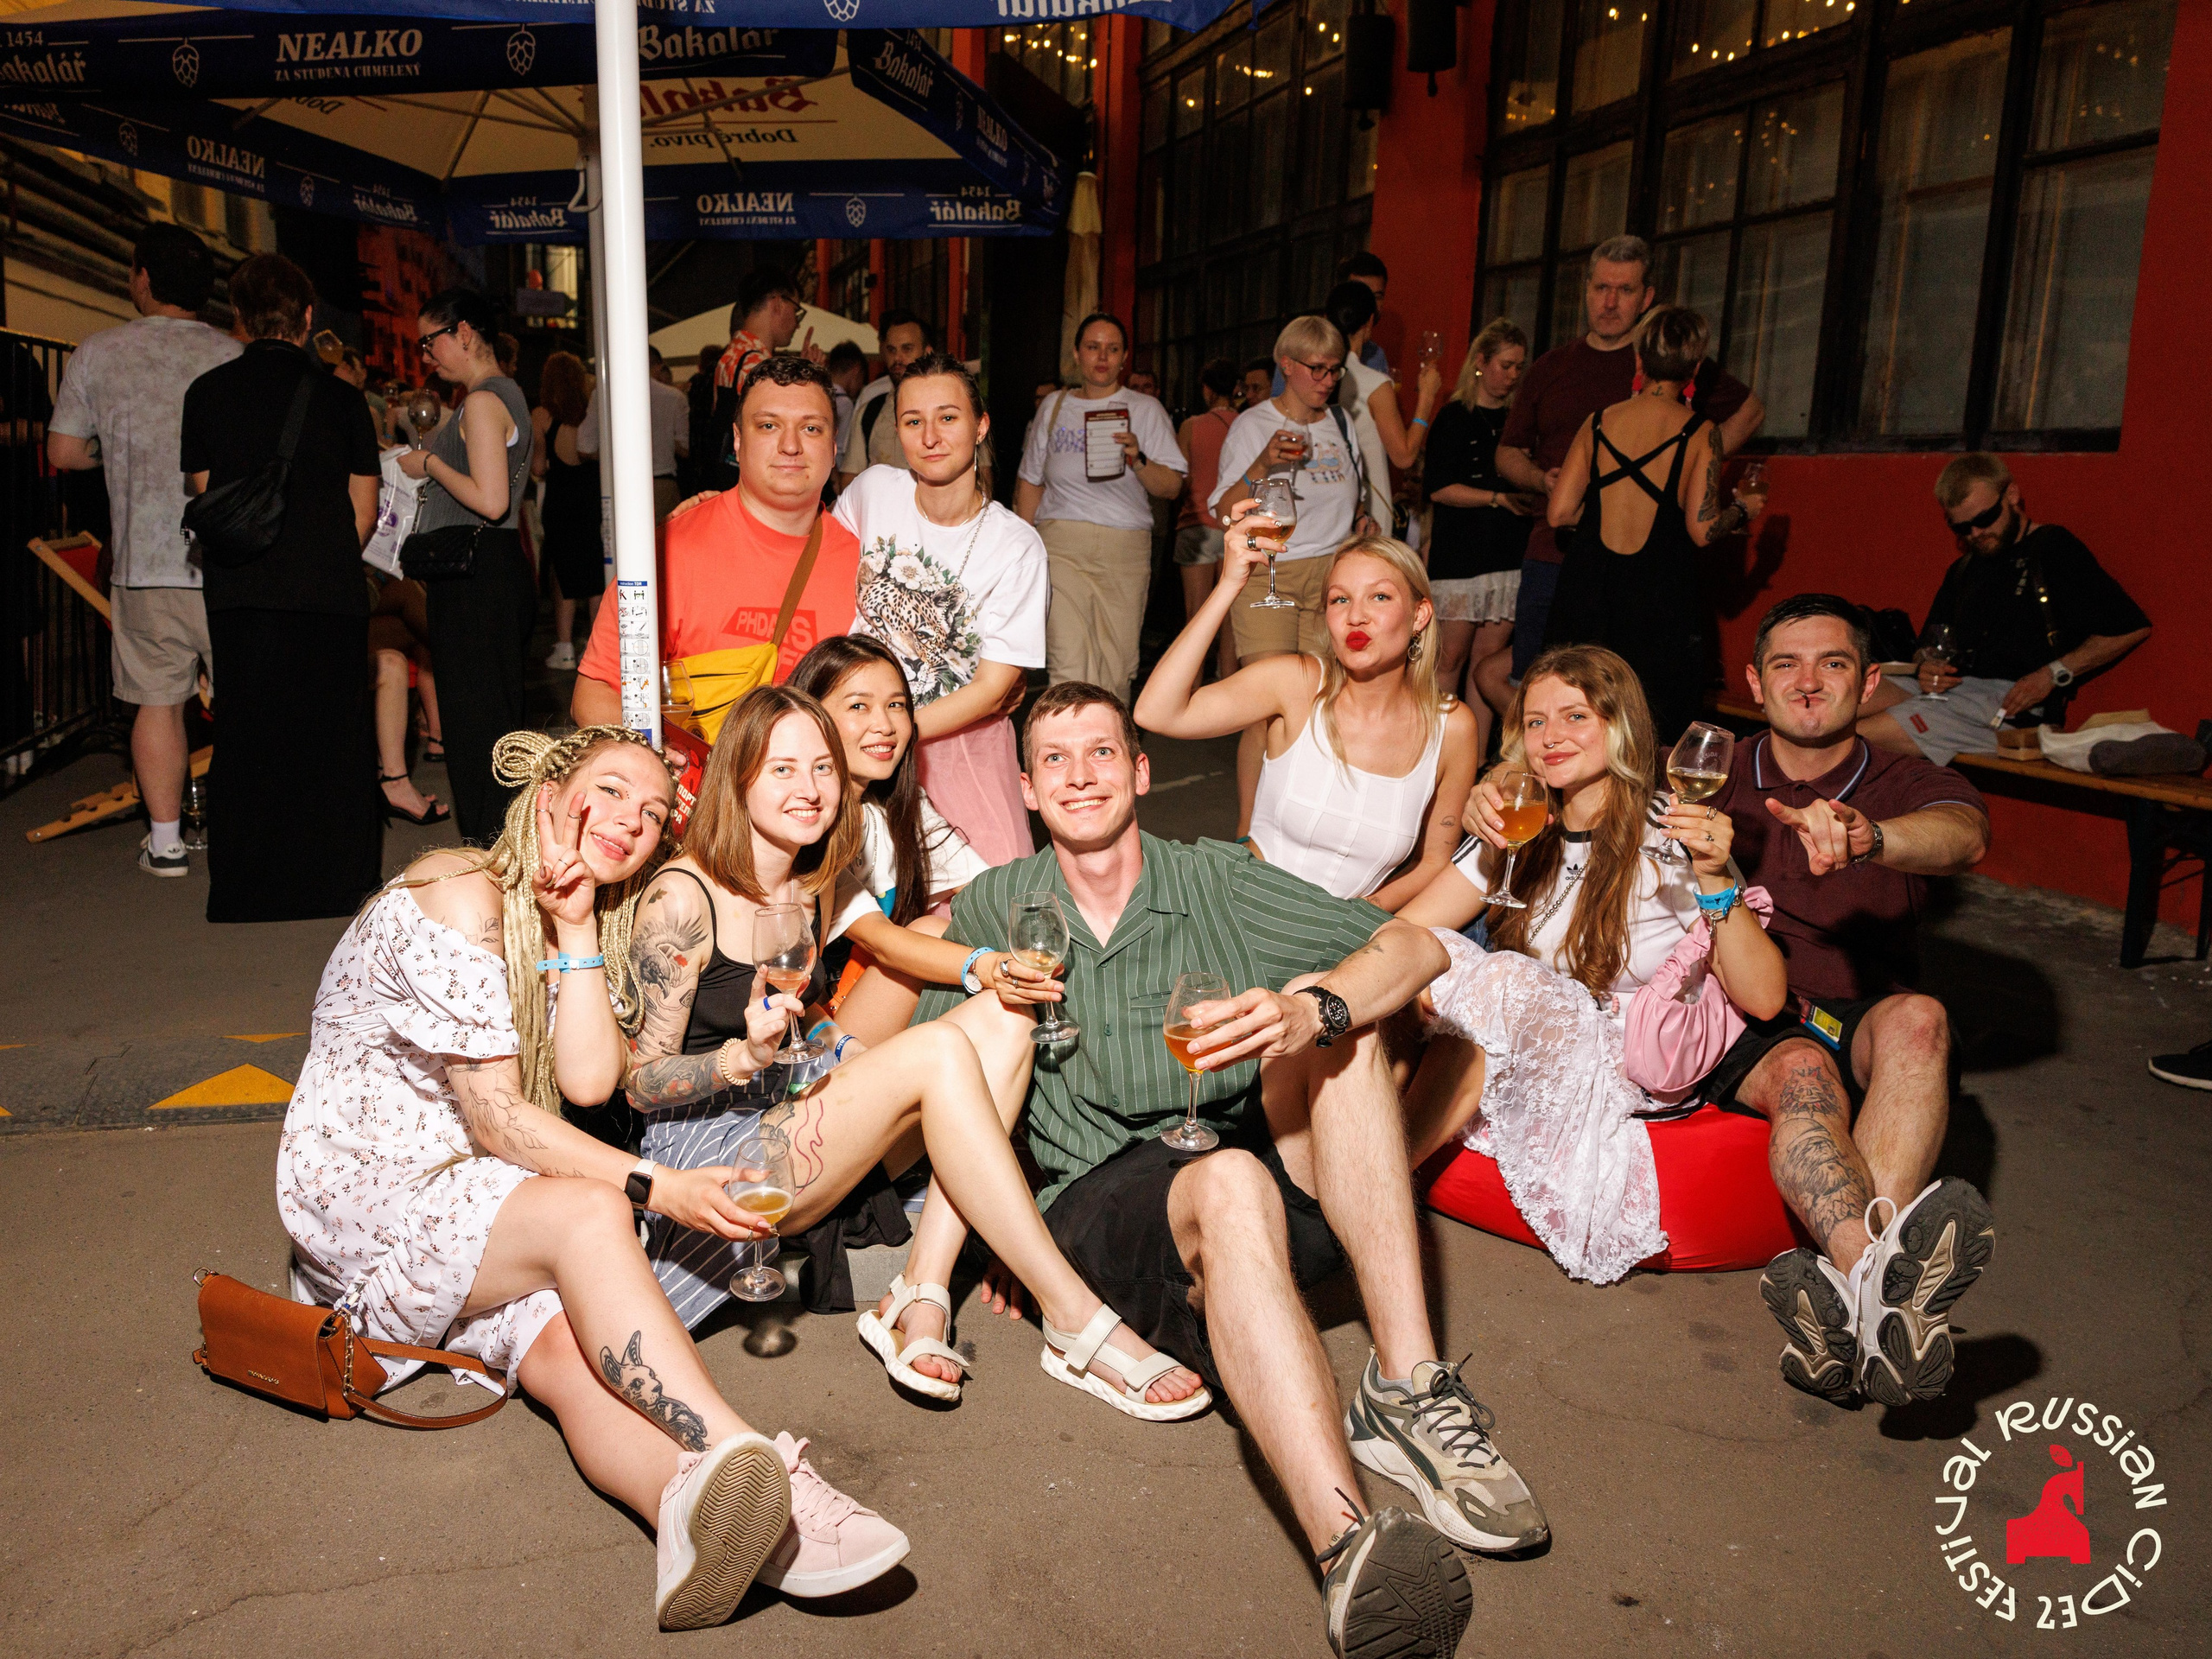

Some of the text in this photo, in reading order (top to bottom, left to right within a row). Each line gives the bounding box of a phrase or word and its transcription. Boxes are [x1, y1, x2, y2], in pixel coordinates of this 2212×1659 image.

[7, 31, 43, 48] 1454
[276, 29, 423, 63] NEALKO
[0, 49, 87, 84] akalář
[735, 610, 814, 653] PHDAS
